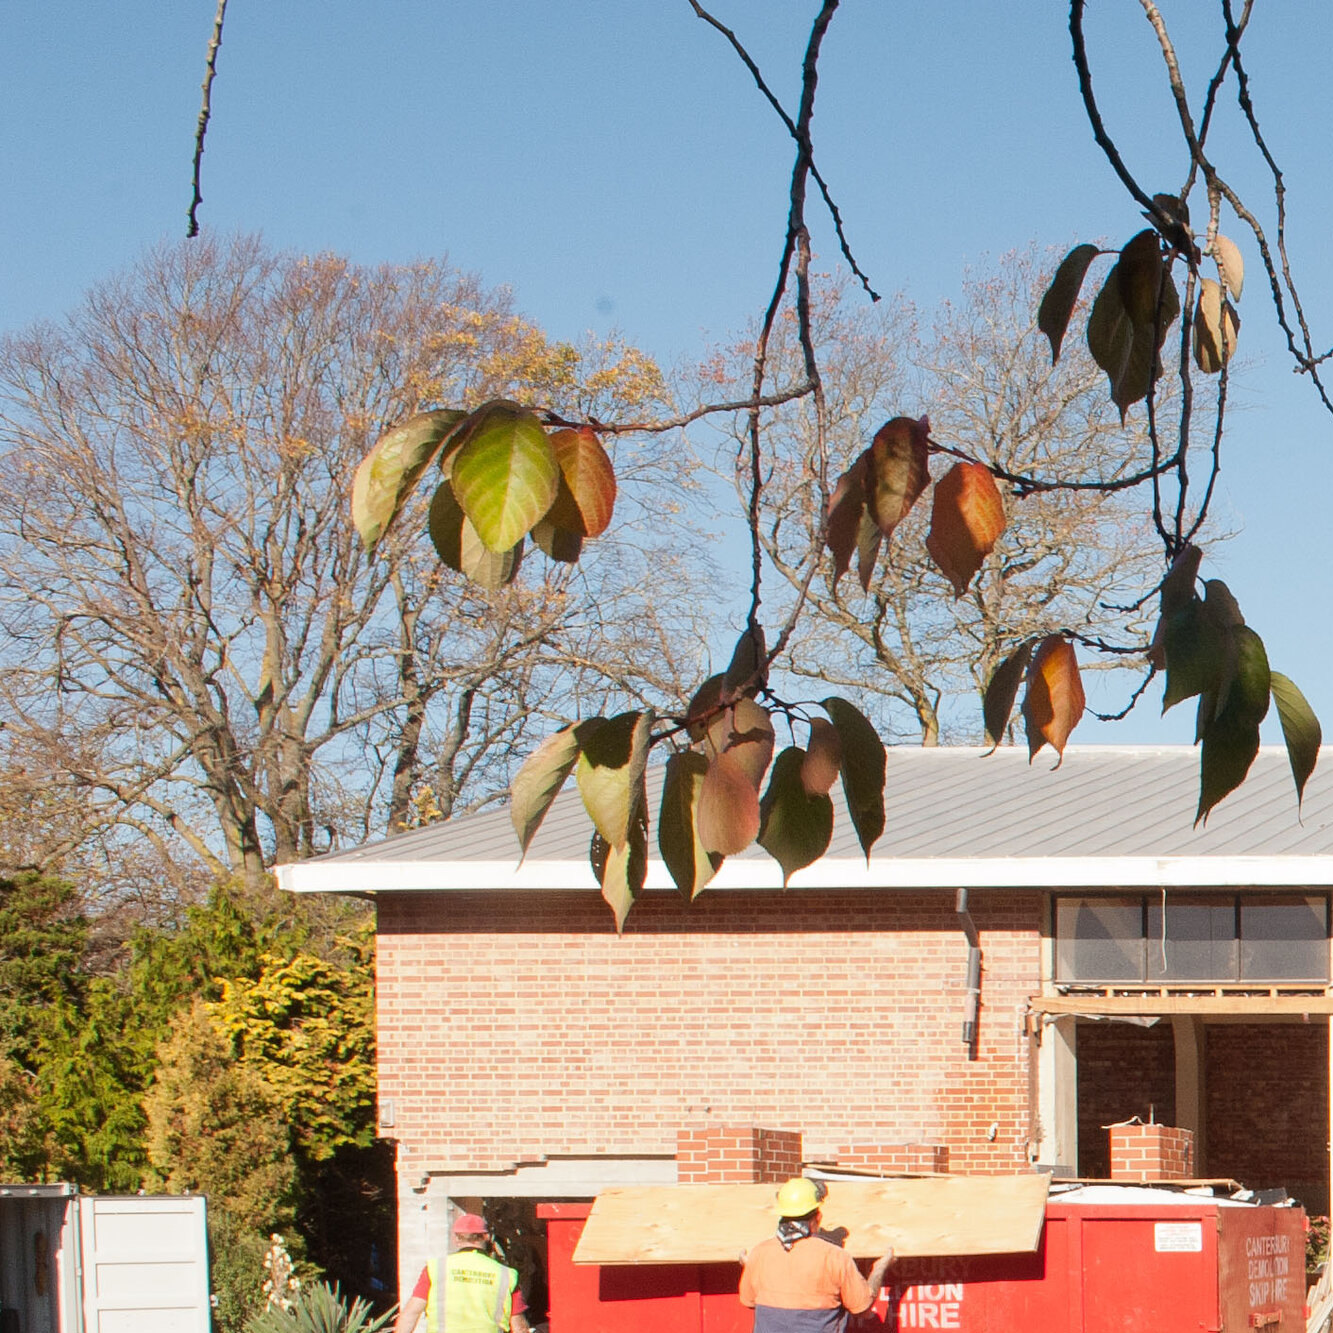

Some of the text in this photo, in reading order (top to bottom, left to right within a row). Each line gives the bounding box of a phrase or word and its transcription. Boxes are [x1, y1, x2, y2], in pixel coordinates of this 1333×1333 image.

[1248, 1257, 1289, 1279] DEMOLTION
[1249, 1278, 1288, 1308] SKIP HIRE
[888, 1302, 961, 1329] HIRE
